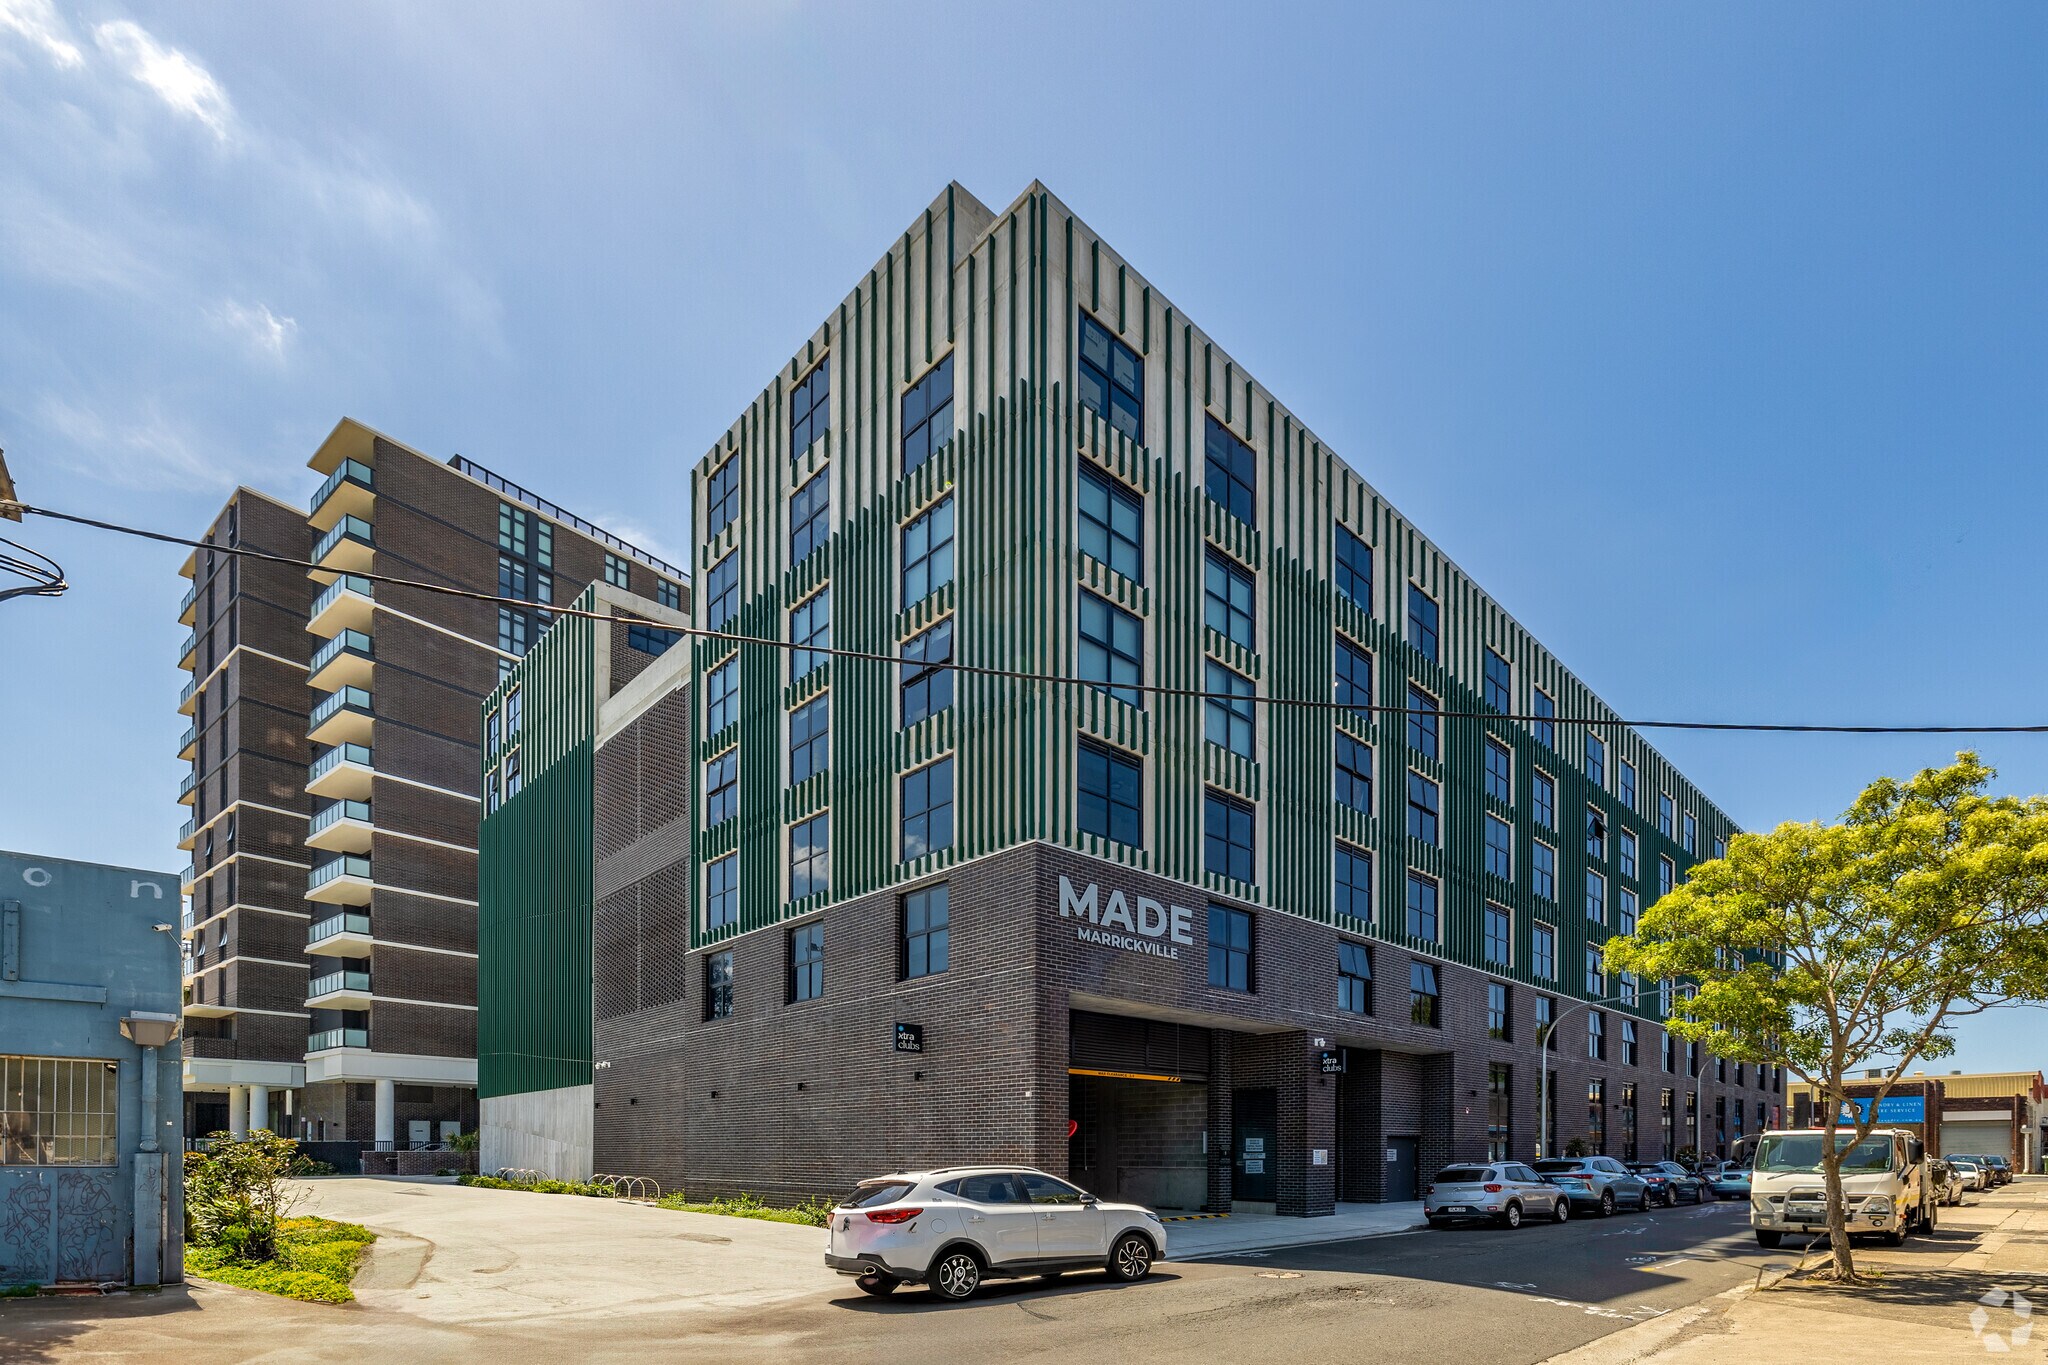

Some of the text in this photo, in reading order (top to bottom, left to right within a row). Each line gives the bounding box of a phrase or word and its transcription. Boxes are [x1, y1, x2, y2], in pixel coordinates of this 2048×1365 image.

[1058, 874, 1193, 946] MADE
[1077, 926, 1179, 960] MARRICKVILLE
[897, 1032, 915, 1041] xtra
[897, 1040, 920, 1051] clubs
[1322, 1057, 1338, 1065] xtra
[1322, 1064, 1342, 1072] clubs
